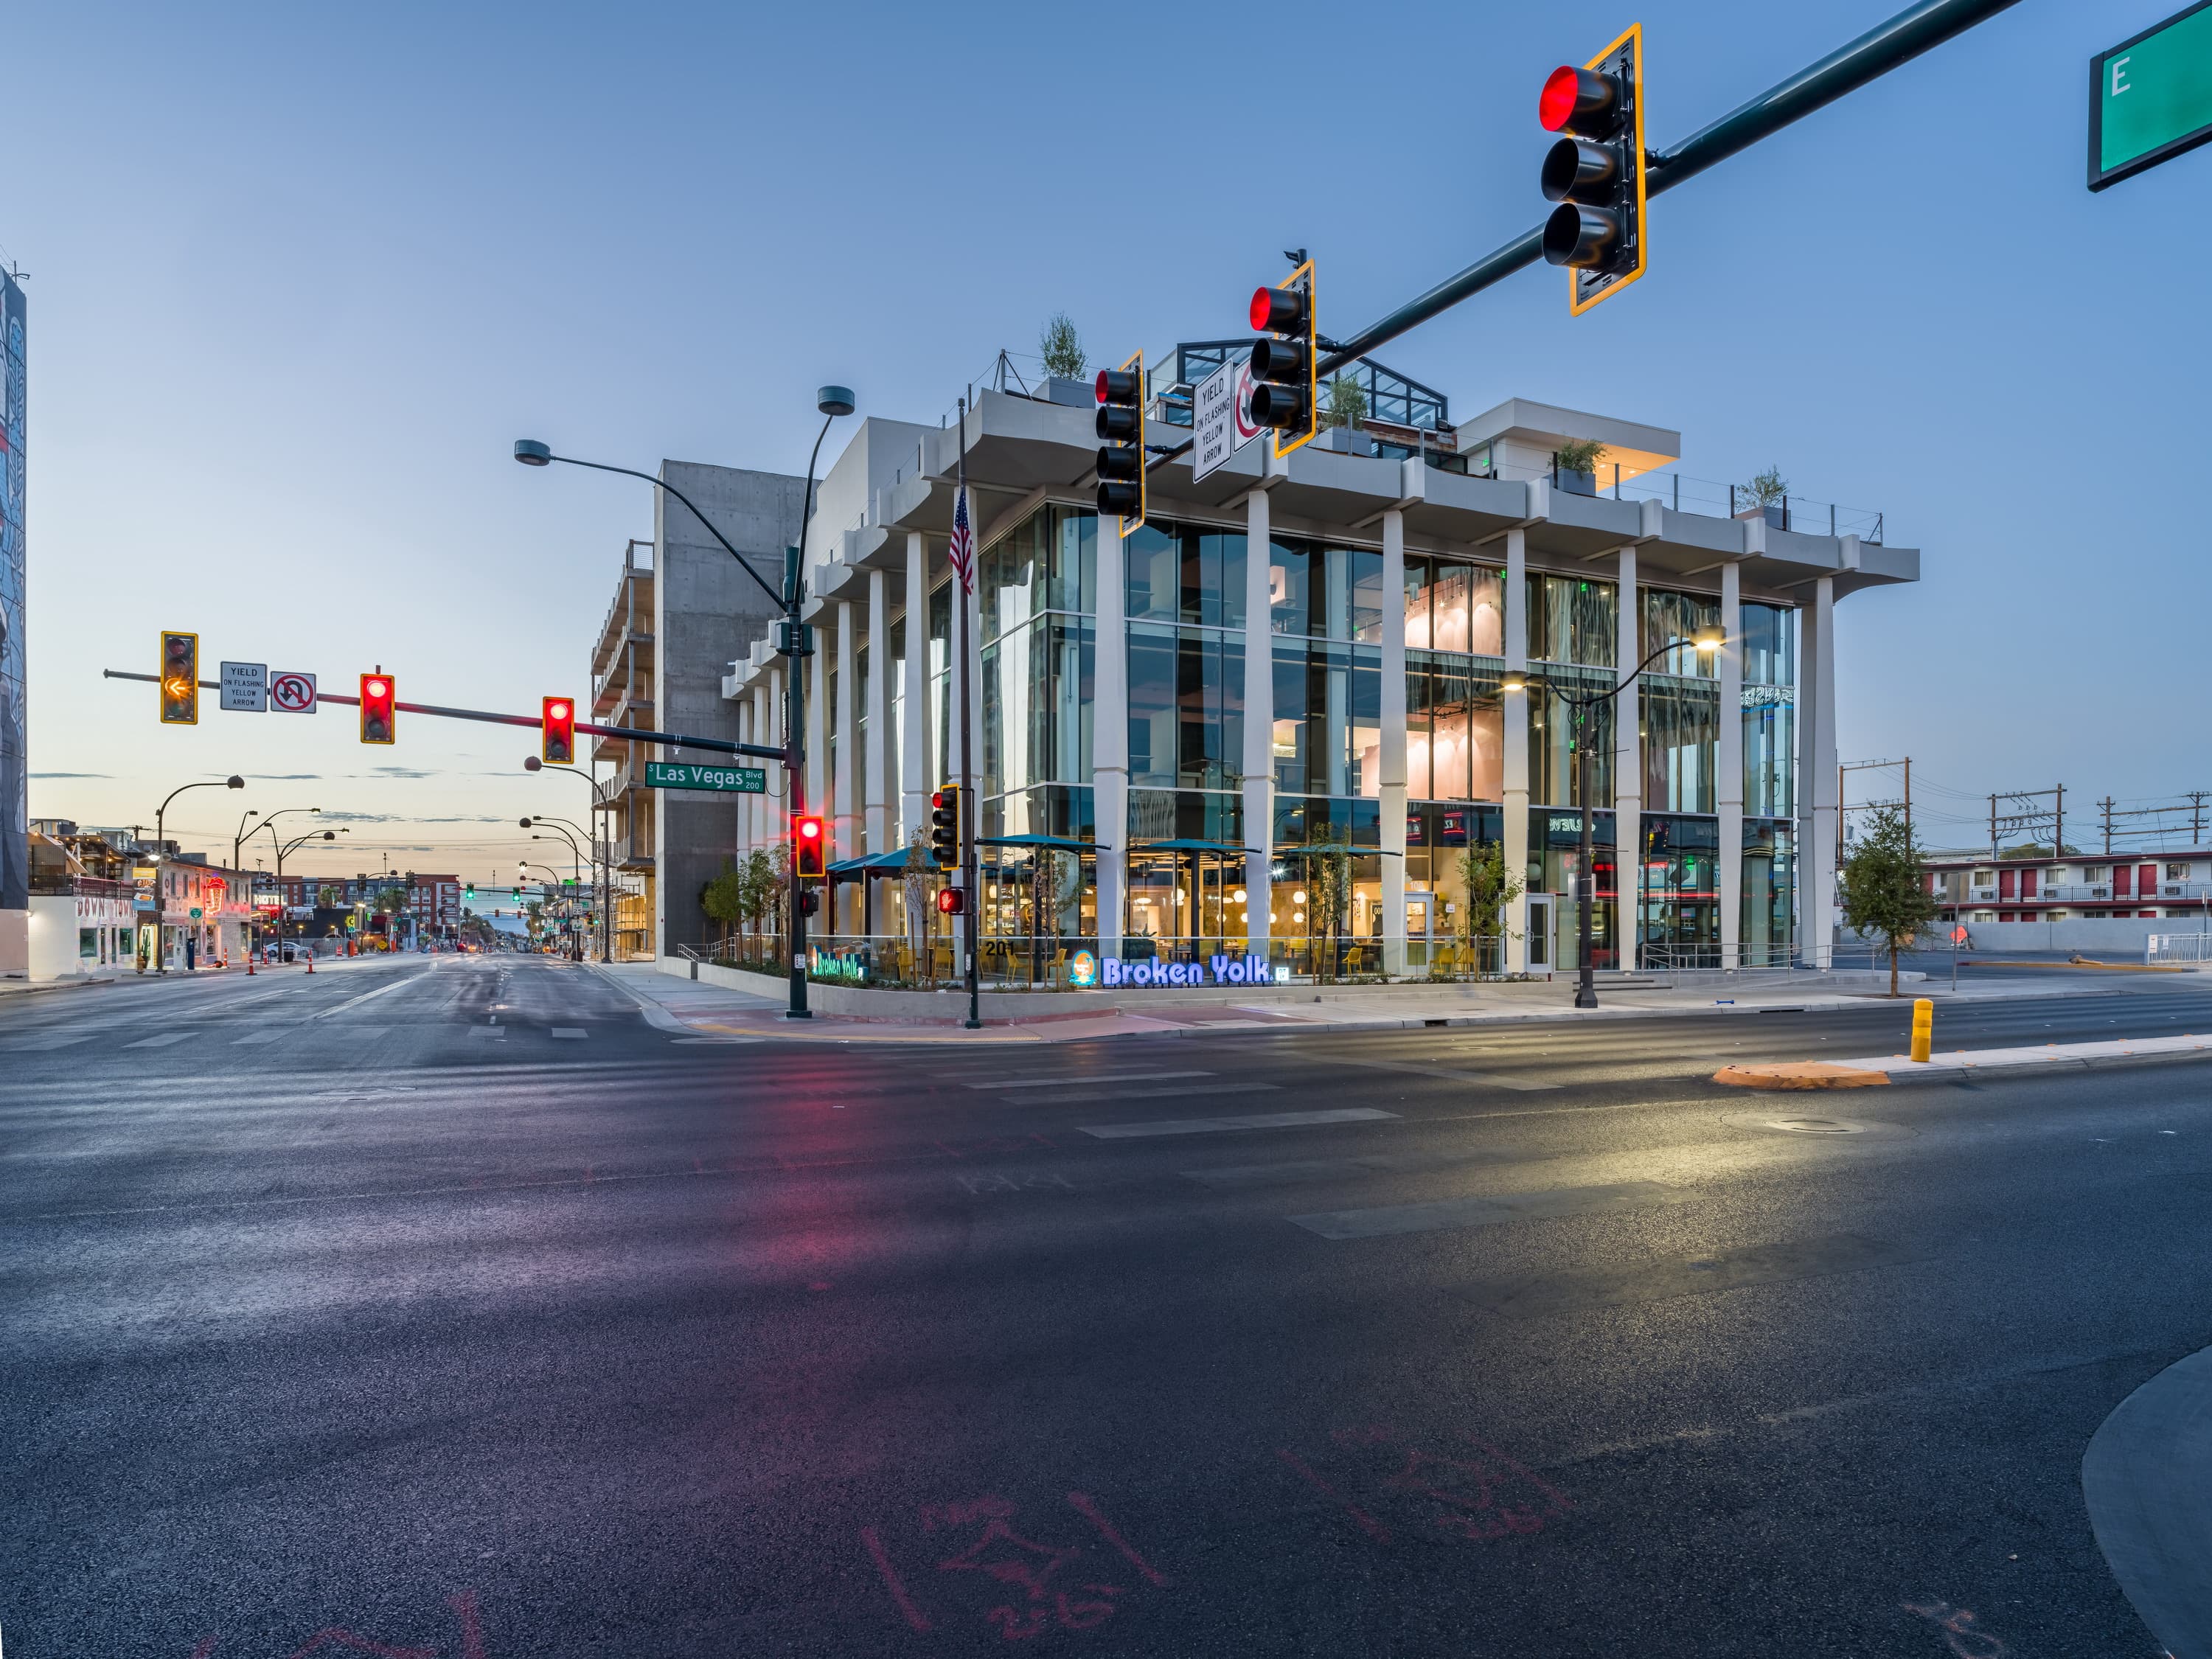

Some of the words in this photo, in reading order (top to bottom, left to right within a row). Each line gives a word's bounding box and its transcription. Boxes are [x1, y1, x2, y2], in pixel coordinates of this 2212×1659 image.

[2111, 56, 2131, 97] E
[1202, 378, 1224, 406] YIELD
[1197, 419, 1204, 432] ON
[1205, 397, 1230, 425] FLASHING
[1202, 422, 1222, 447] YELLOW
[1203, 442, 1222, 466] ARROW
[230, 667, 257, 677] YIELD
[232, 689, 256, 697] YELLOW
[234, 679, 264, 688] FLASHING
[232, 698, 255, 706] ARROW
[655, 764, 686, 782] Las
[691, 766, 743, 788] Vegas
[745, 771, 762, 779] Blvd
[745, 782, 759, 790] 200
[77, 897, 105, 917] DOWN
[254, 894, 288, 905] HOTEL
[985, 941, 1015, 956] 201
[818, 952, 841, 975] Broken
[841, 953, 859, 978] Yolk
[1101, 956, 1204, 984] Broken
